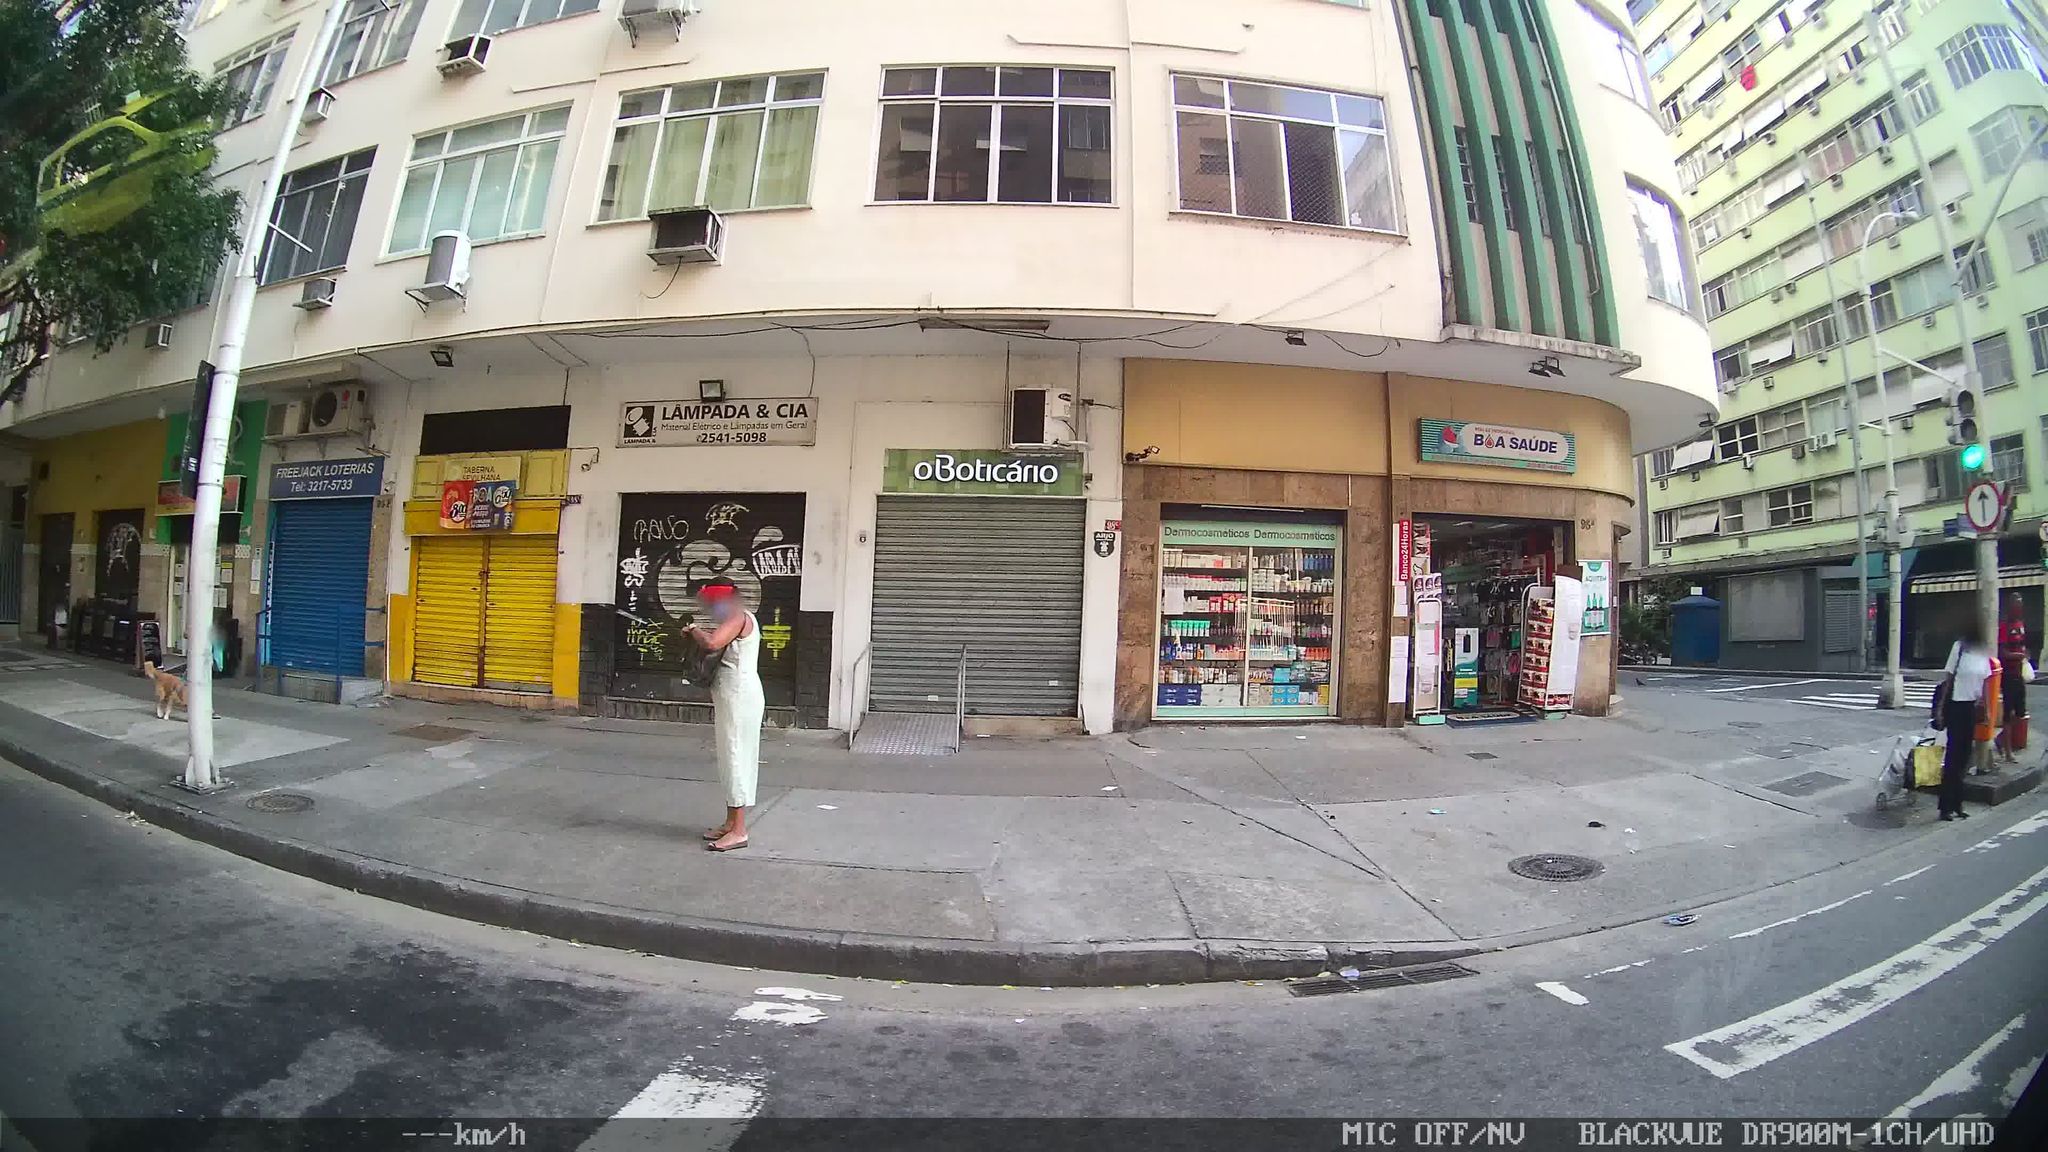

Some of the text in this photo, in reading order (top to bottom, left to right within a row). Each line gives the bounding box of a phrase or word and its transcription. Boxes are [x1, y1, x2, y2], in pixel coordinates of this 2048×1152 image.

[661, 402, 809, 421] LÂMPADA & CIA
[785, 420, 808, 430] Geral
[701, 431, 767, 444] 2541-5098
[1473, 433, 1506, 449] BOA
[1509, 435, 1558, 454] SAÚDE
[276, 462, 375, 479] FREEJACK LOTERIAS
[463, 466, 495, 474] TABERNA
[914, 454, 1059, 483] oBoticário
[307, 479, 353, 492] 3217-5733
[1400, 521, 1409, 580] Banco24Horas
